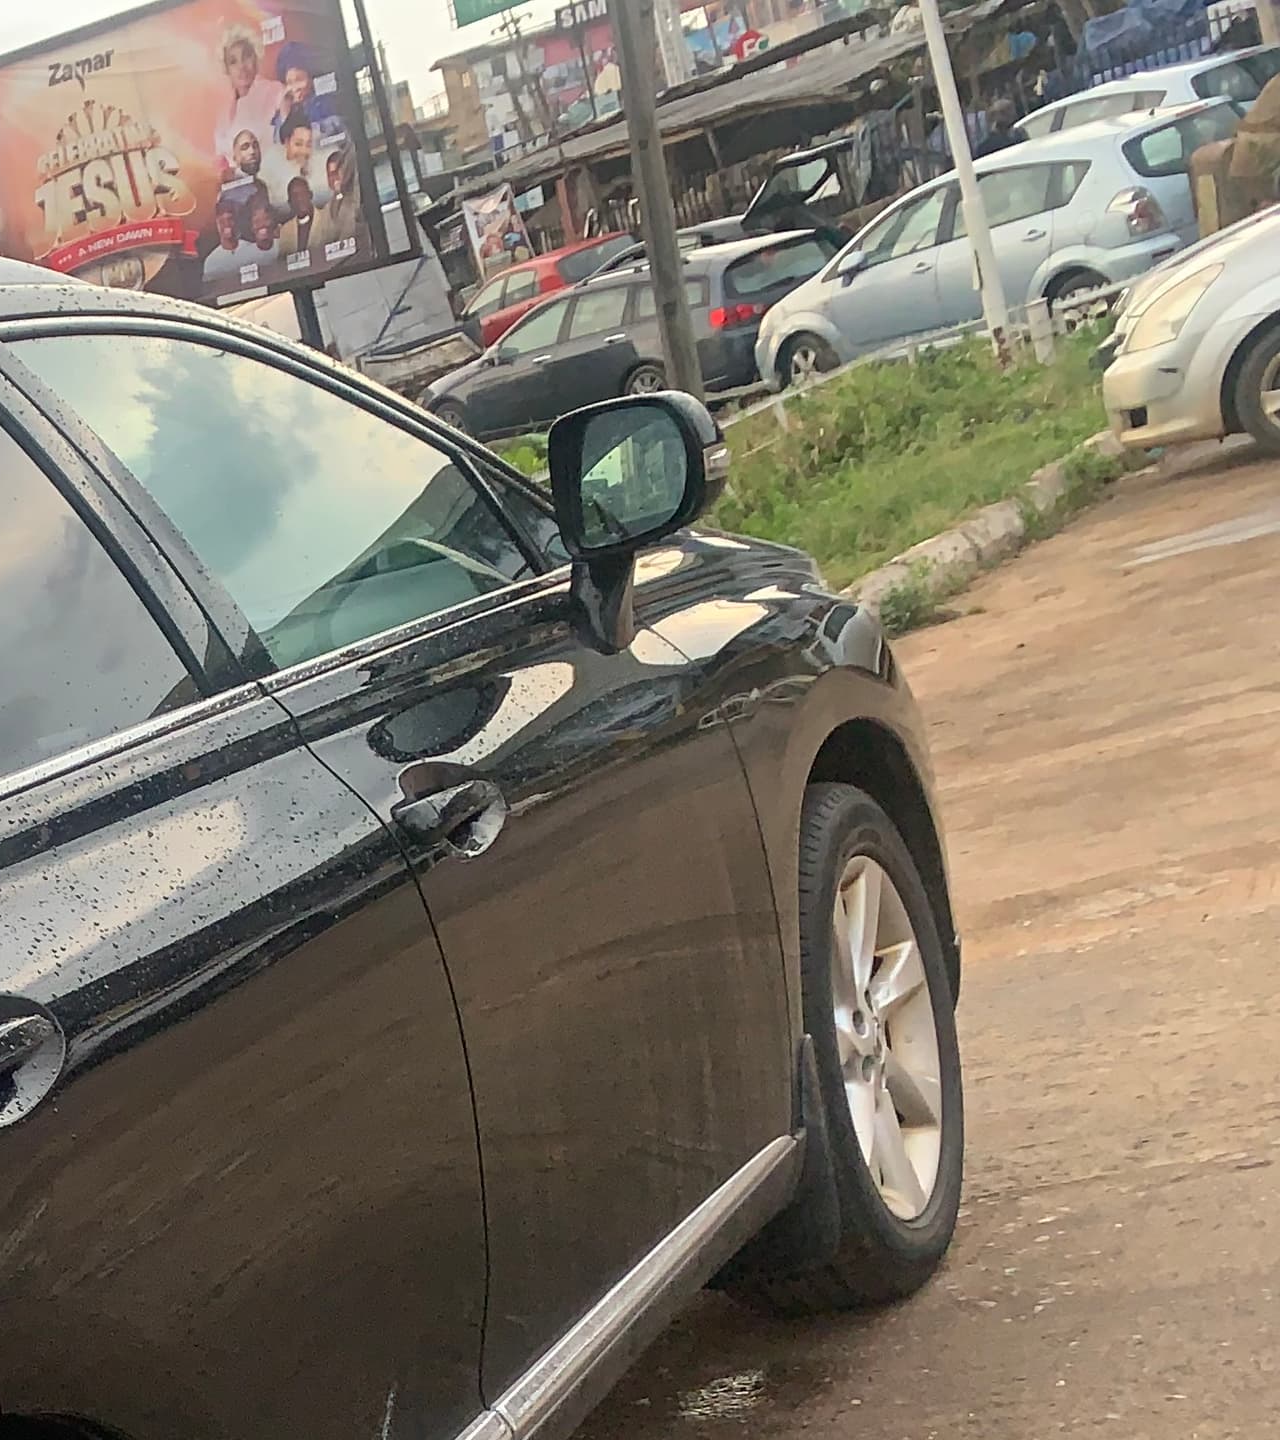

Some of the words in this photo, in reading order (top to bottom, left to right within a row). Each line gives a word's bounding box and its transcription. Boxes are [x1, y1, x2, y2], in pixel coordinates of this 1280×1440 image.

[48, 49, 115, 88] Zamar
[34, 147, 197, 259] JESUS
[78, 246, 87, 256] A
[89, 236, 115, 251] NEW
[116, 227, 153, 243] DAWN
